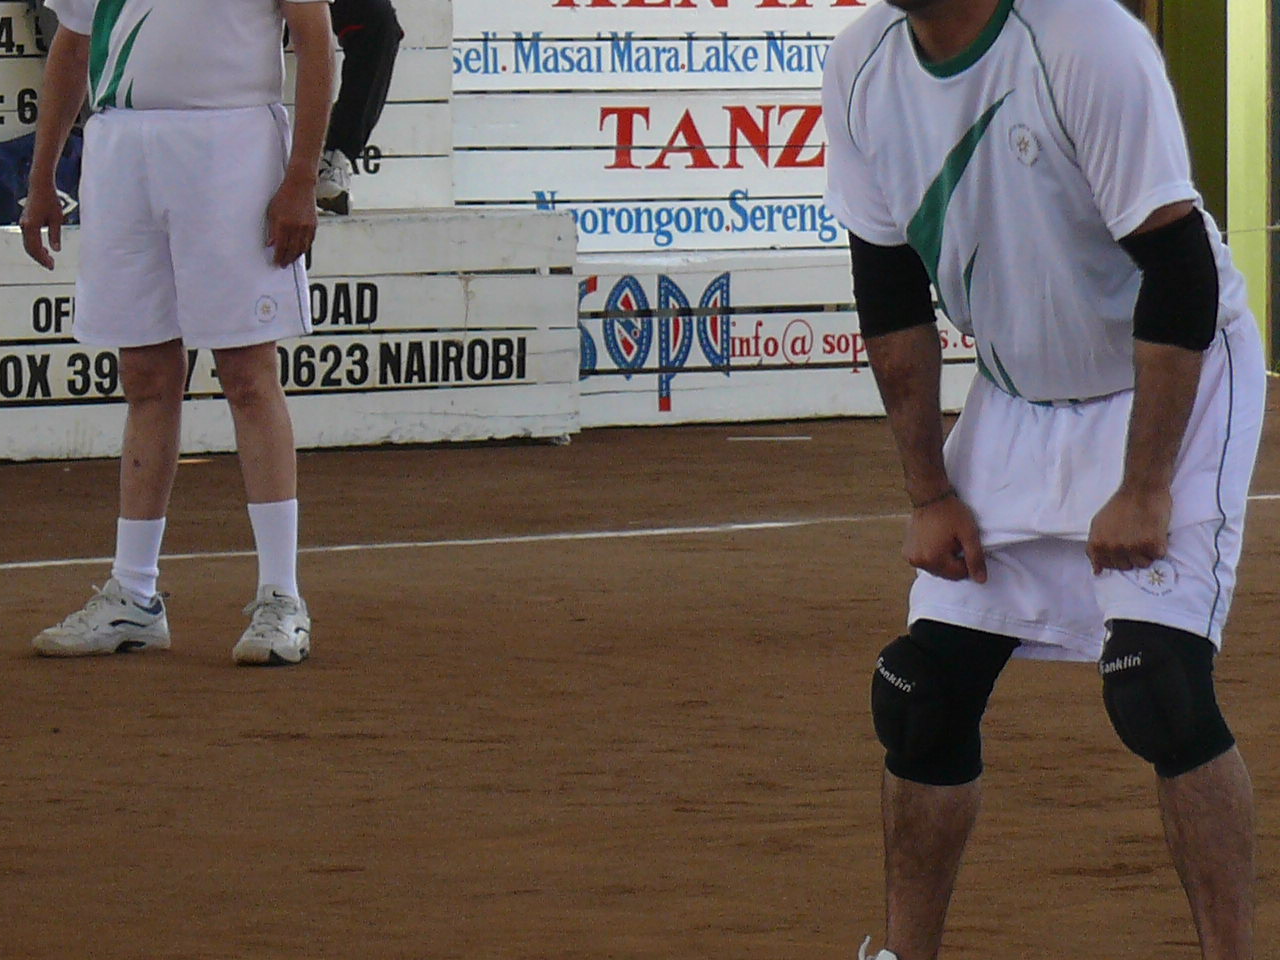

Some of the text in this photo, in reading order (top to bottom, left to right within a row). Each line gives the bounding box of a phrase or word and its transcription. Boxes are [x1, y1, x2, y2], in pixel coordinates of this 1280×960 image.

[513, 31, 602, 74] Masai
[763, 30, 830, 73] Naiv
[599, 105, 824, 169] TANZ
[729, 188, 840, 242] Sereng
[32, 296, 74, 333] OF
[310, 283, 378, 326] OAD
[379, 337, 527, 384] NAIROBI
